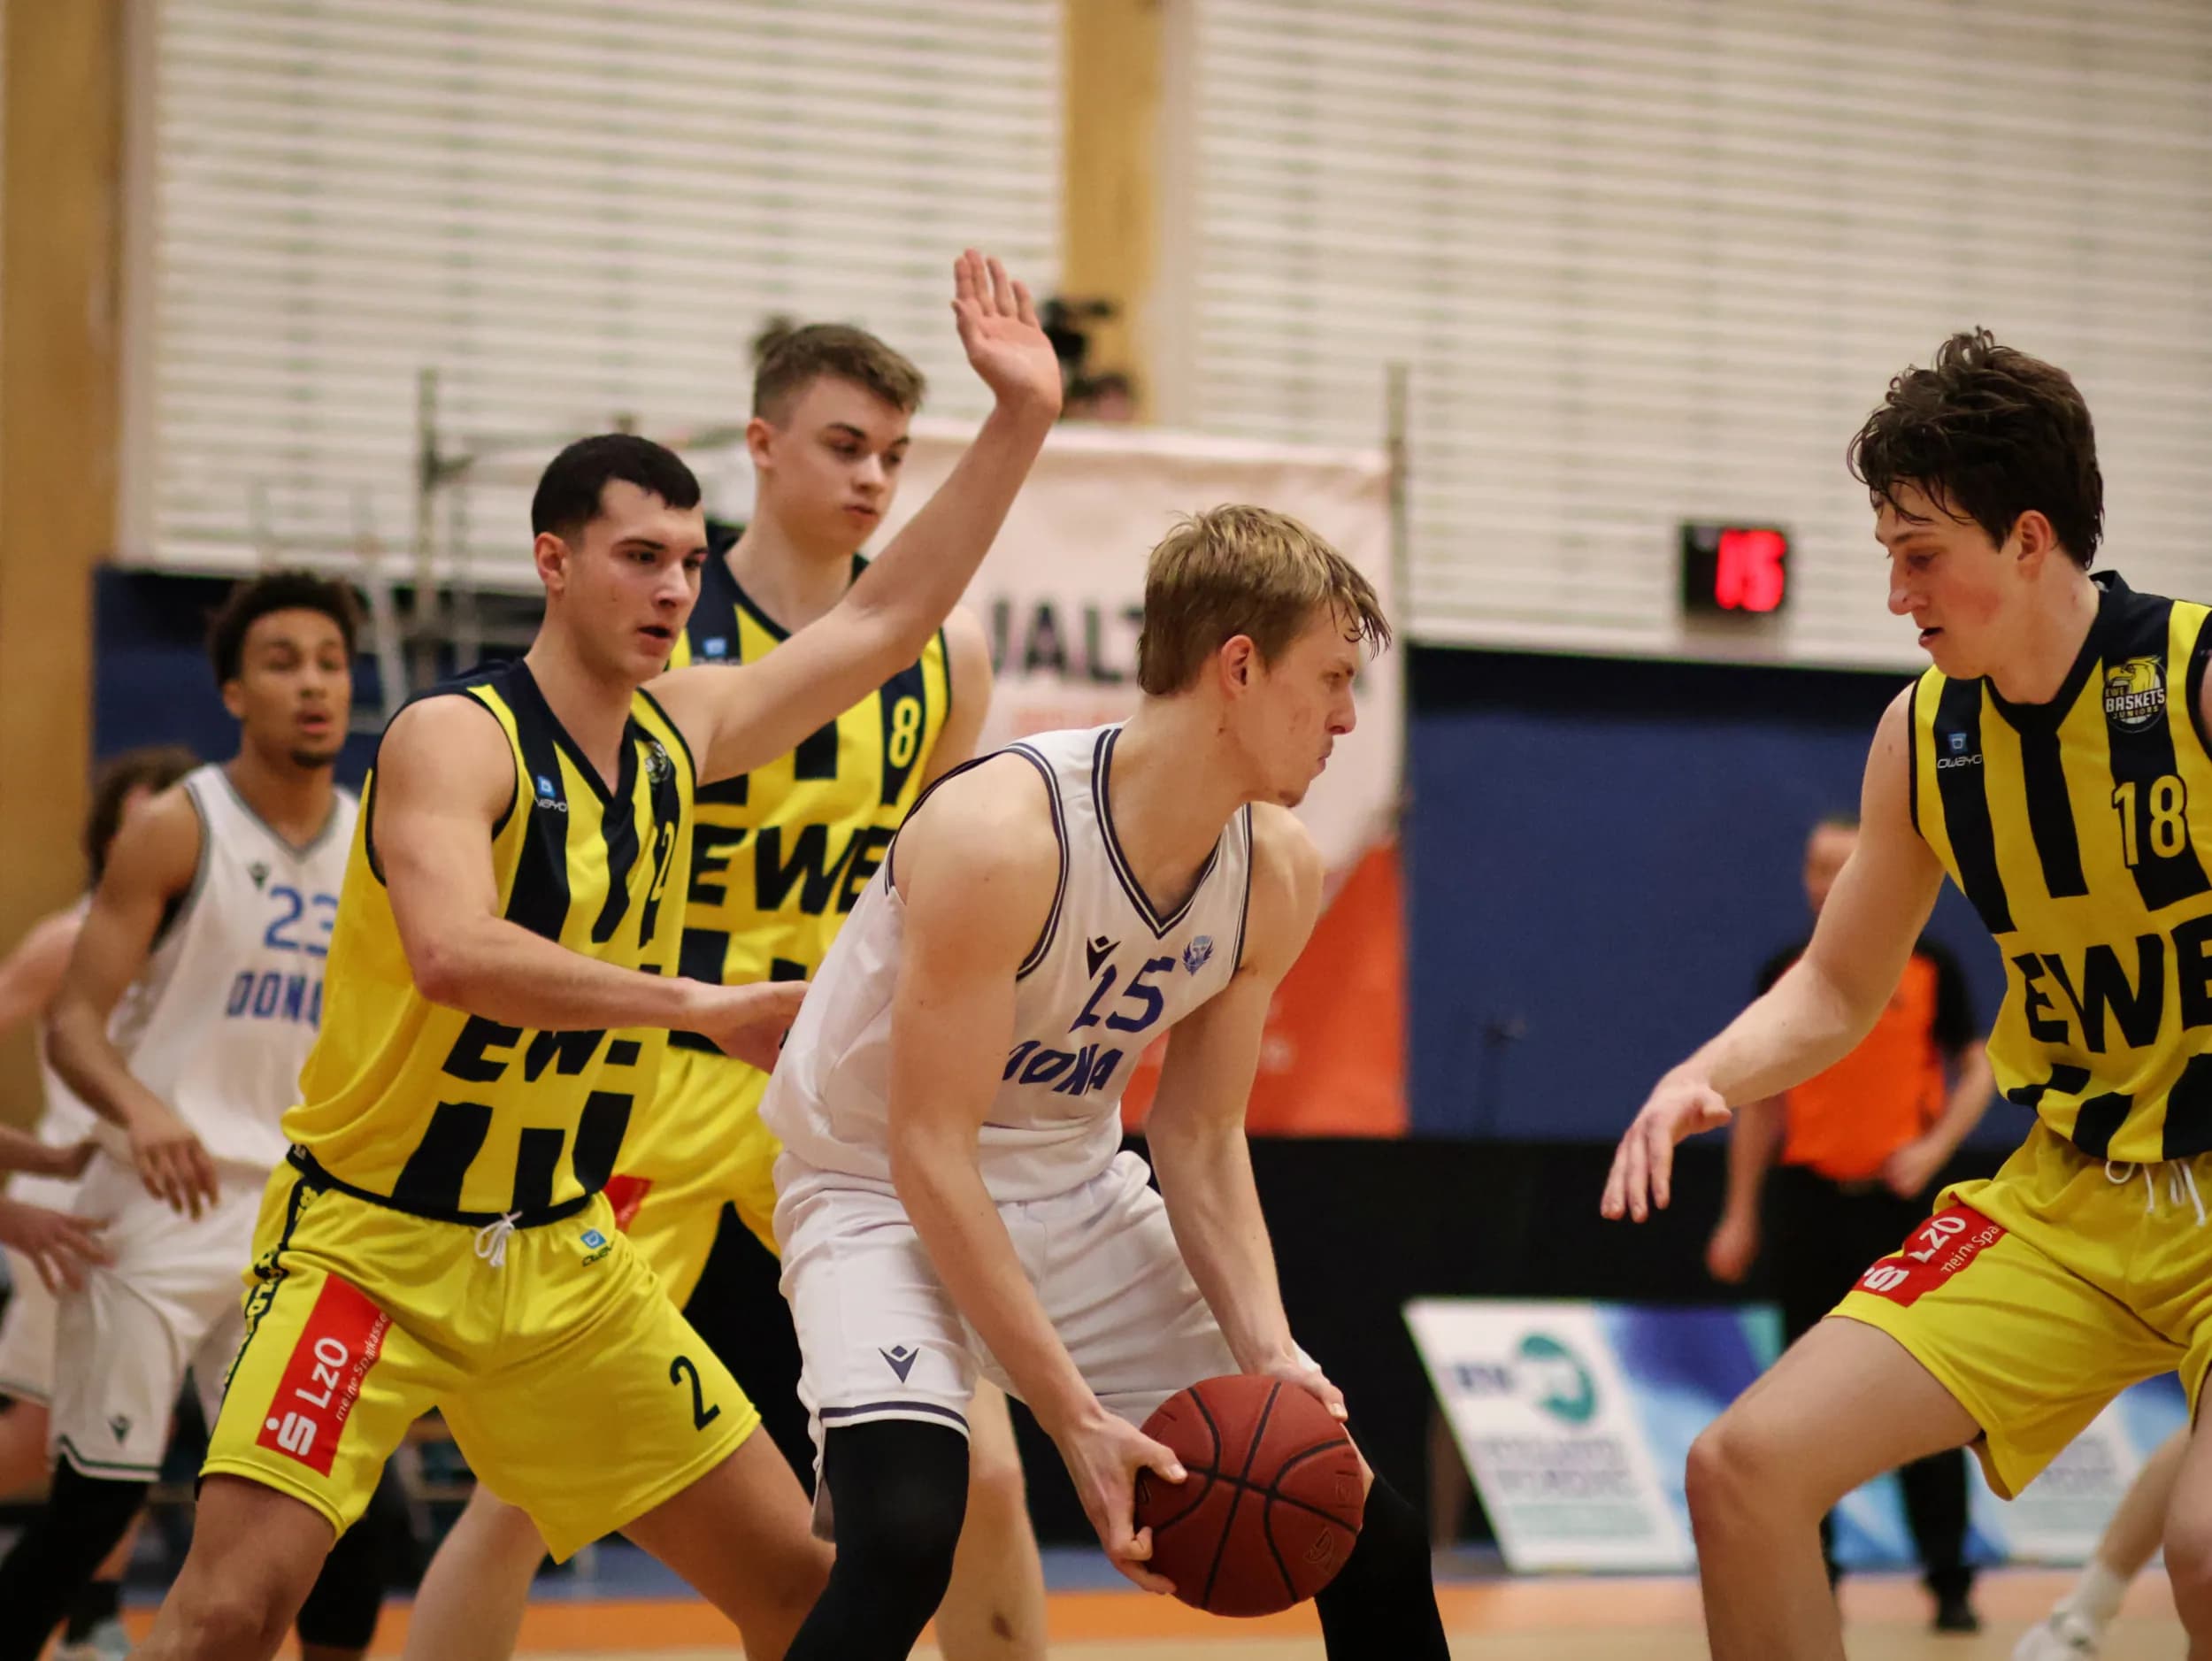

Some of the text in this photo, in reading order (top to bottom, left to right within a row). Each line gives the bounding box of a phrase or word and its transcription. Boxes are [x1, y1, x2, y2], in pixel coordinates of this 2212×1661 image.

[888, 695, 921, 769] 8
[2106, 688, 2165, 713] BASKETS
[2111, 704, 2159, 720] JUNIORS
[2112, 773, 2187, 867] 18
[687, 823, 897, 916] EWE
[265, 886, 339, 957] 23
[295, 1336, 349, 1410] LzO
[669, 1354, 721, 1432] 2
